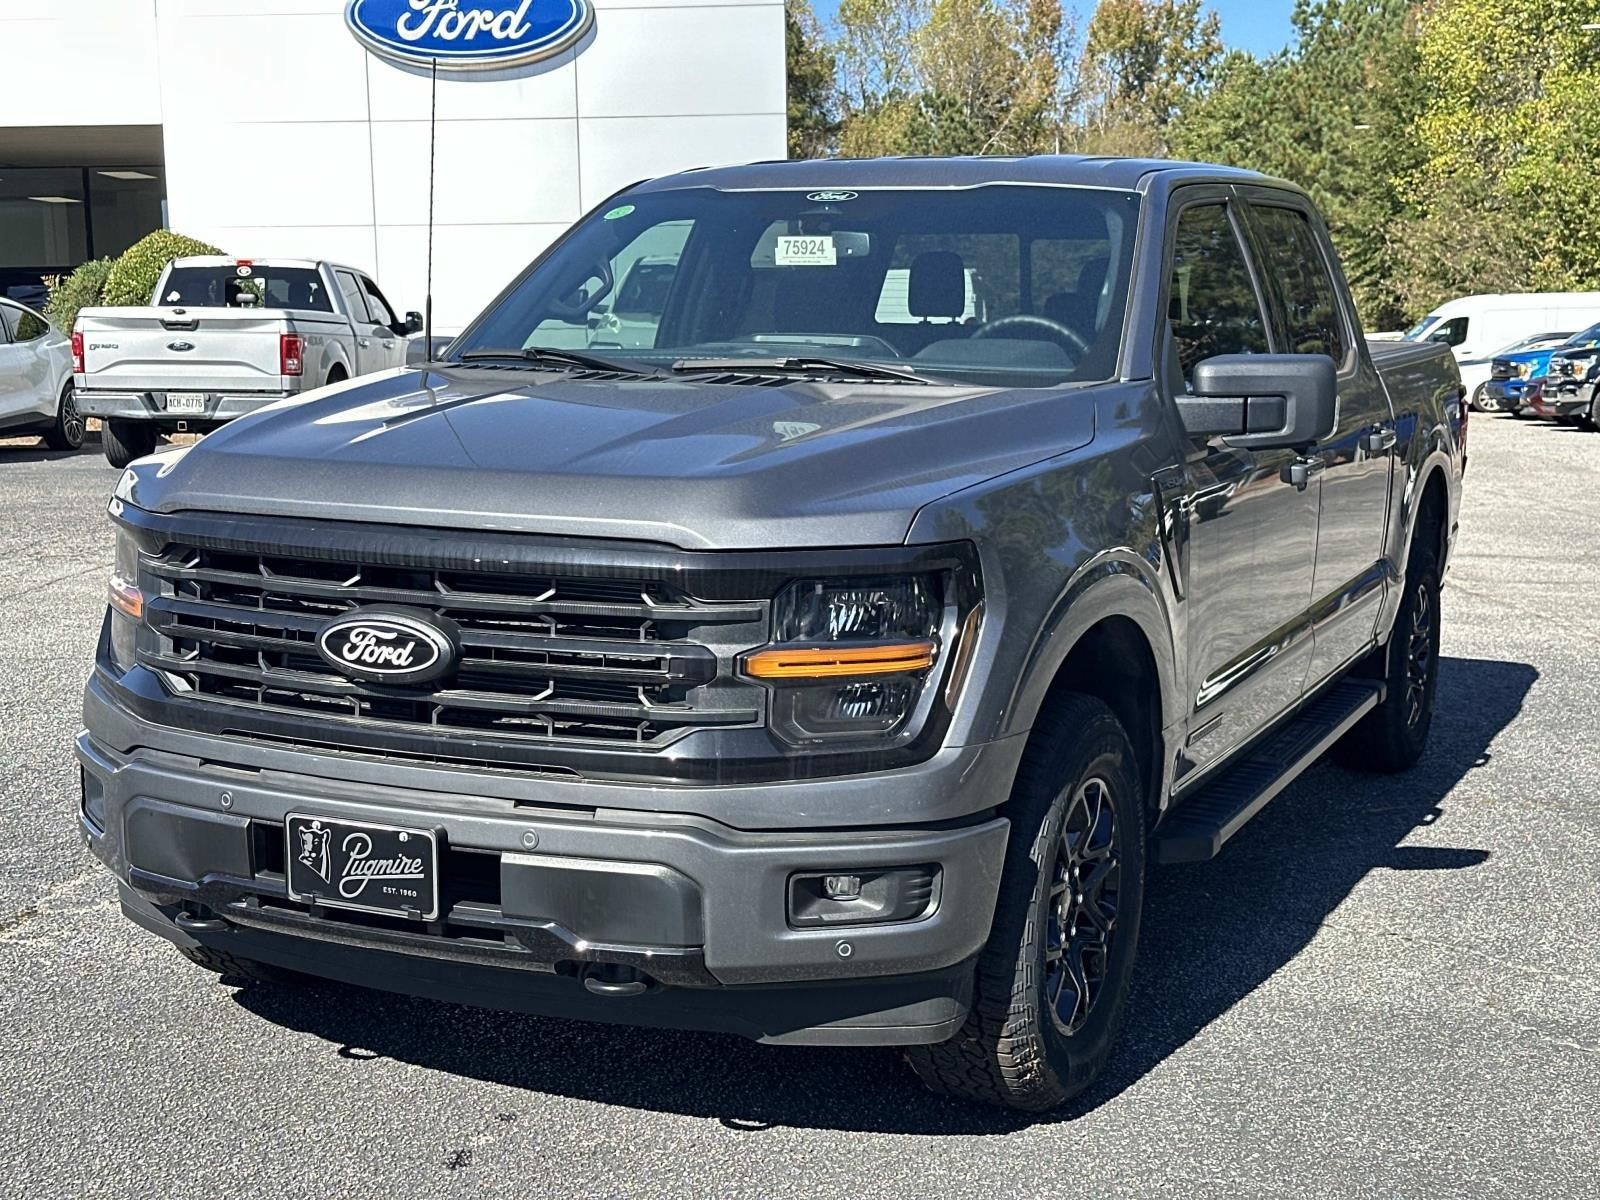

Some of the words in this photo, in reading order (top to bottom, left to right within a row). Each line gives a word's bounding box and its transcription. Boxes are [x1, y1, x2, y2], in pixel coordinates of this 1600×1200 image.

[396, 0, 531, 41] Ford
[783, 239, 826, 255] 75924
[342, 627, 416, 666] Ford
[339, 833, 425, 898] Pugmire
[383, 886, 398, 895] EST.
[399, 888, 417, 898] 1960
